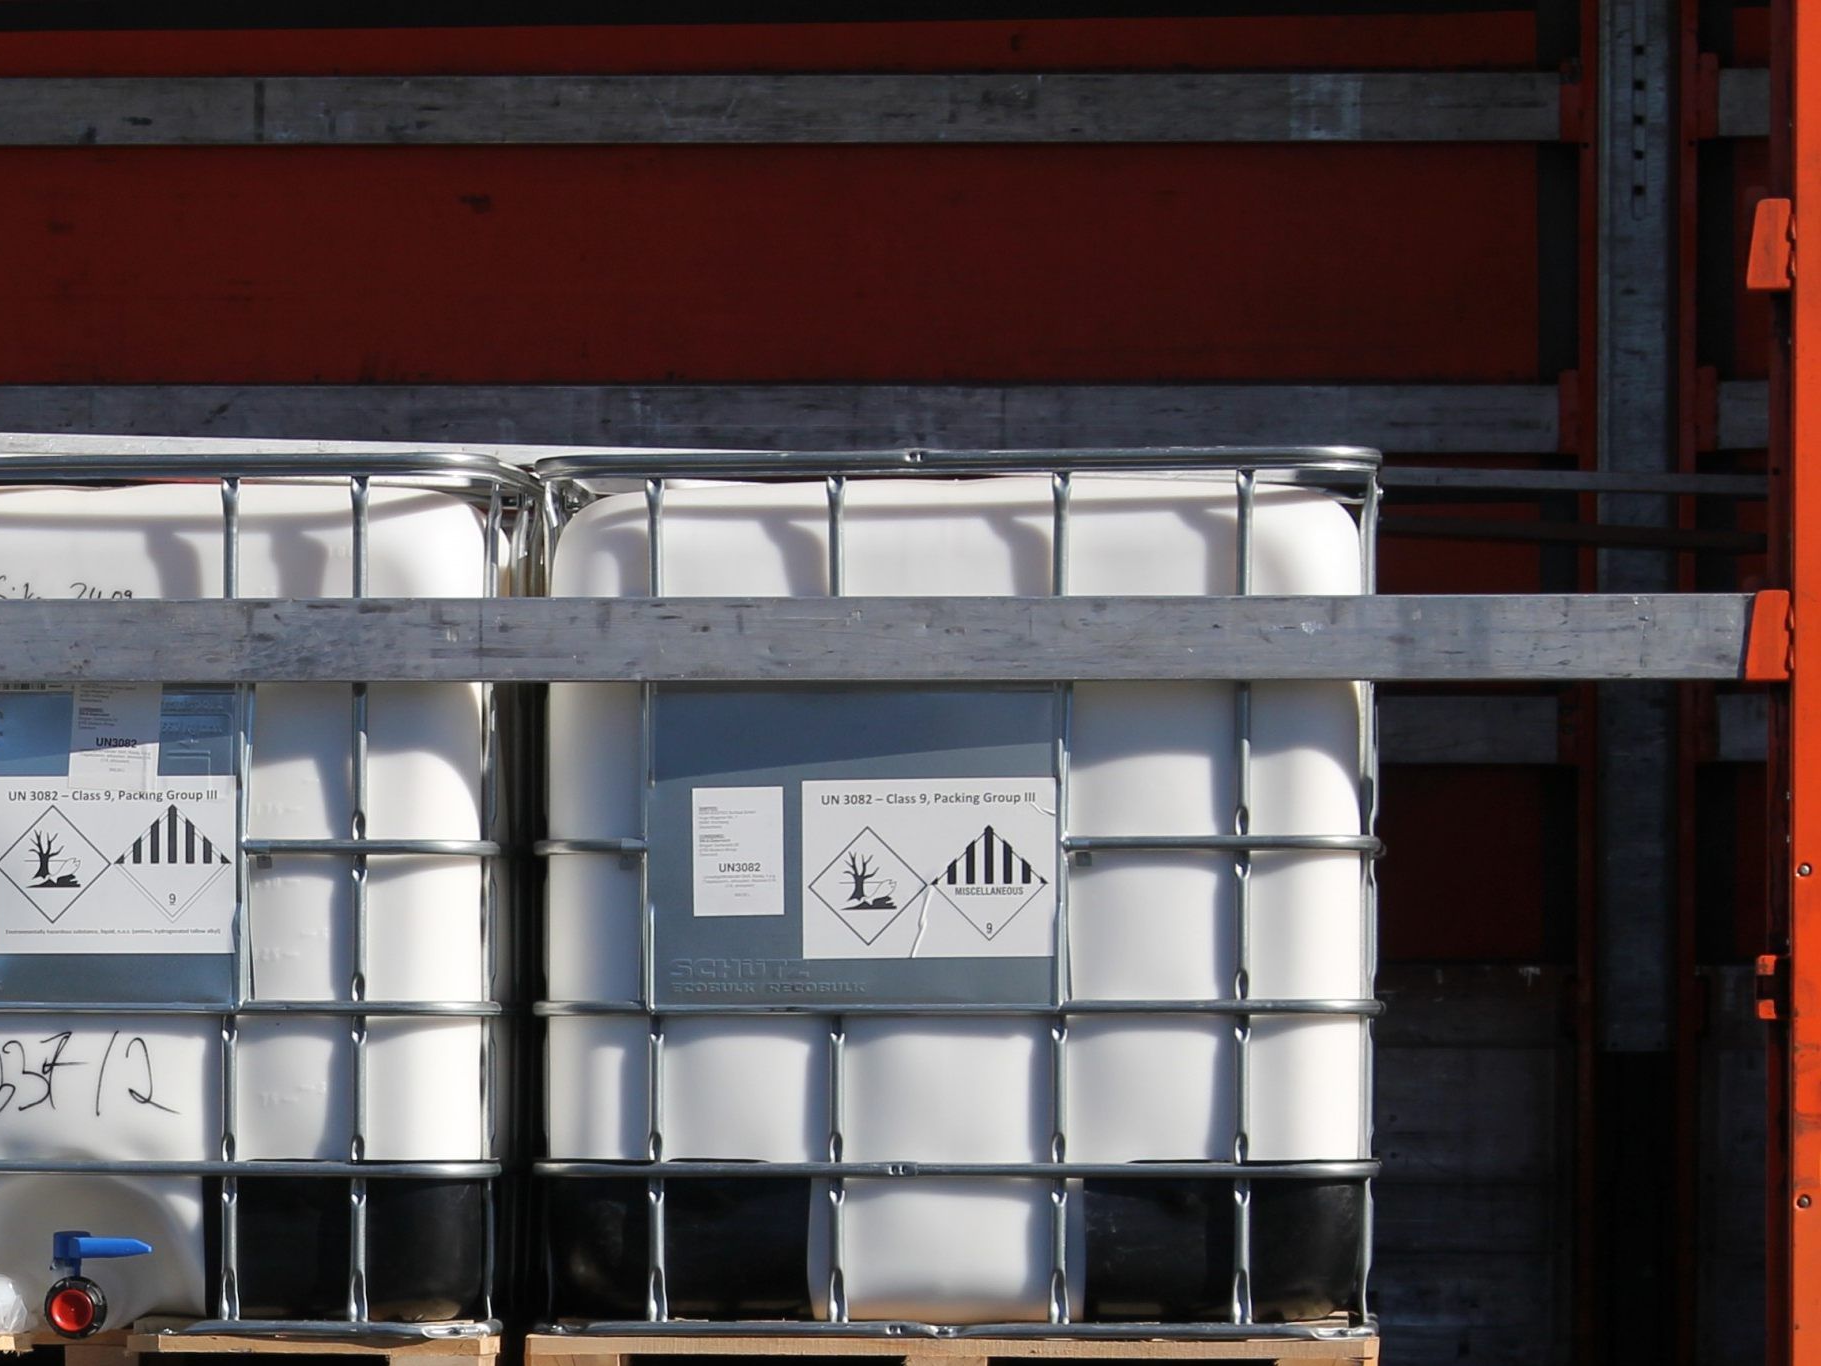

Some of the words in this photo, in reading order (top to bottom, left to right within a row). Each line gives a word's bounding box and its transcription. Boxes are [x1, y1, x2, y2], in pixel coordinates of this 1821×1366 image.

[96, 737, 137, 748] UN3082
[9, 791, 27, 801] UN
[29, 791, 58, 801] 3082
[72, 790, 101, 801] Class
[104, 791, 115, 802] 9,
[118, 790, 163, 802] Packing
[166, 790, 202, 802] Group
[206, 790, 217, 800] III
[821, 795, 840, 805] UN
[843, 794, 872, 805] 3082
[886, 793, 916, 804] Class
[919, 794, 930, 805] 9,
[934, 793, 980, 805] Packing
[983, 792, 1021, 805] Group
[1024, 792, 1036, 802] III
[718, 862, 761, 873] UN3082
[955, 887, 1024, 896] MISCELLANEOUS
[168, 893, 176, 904] 9
[986, 922, 993, 934] 9
